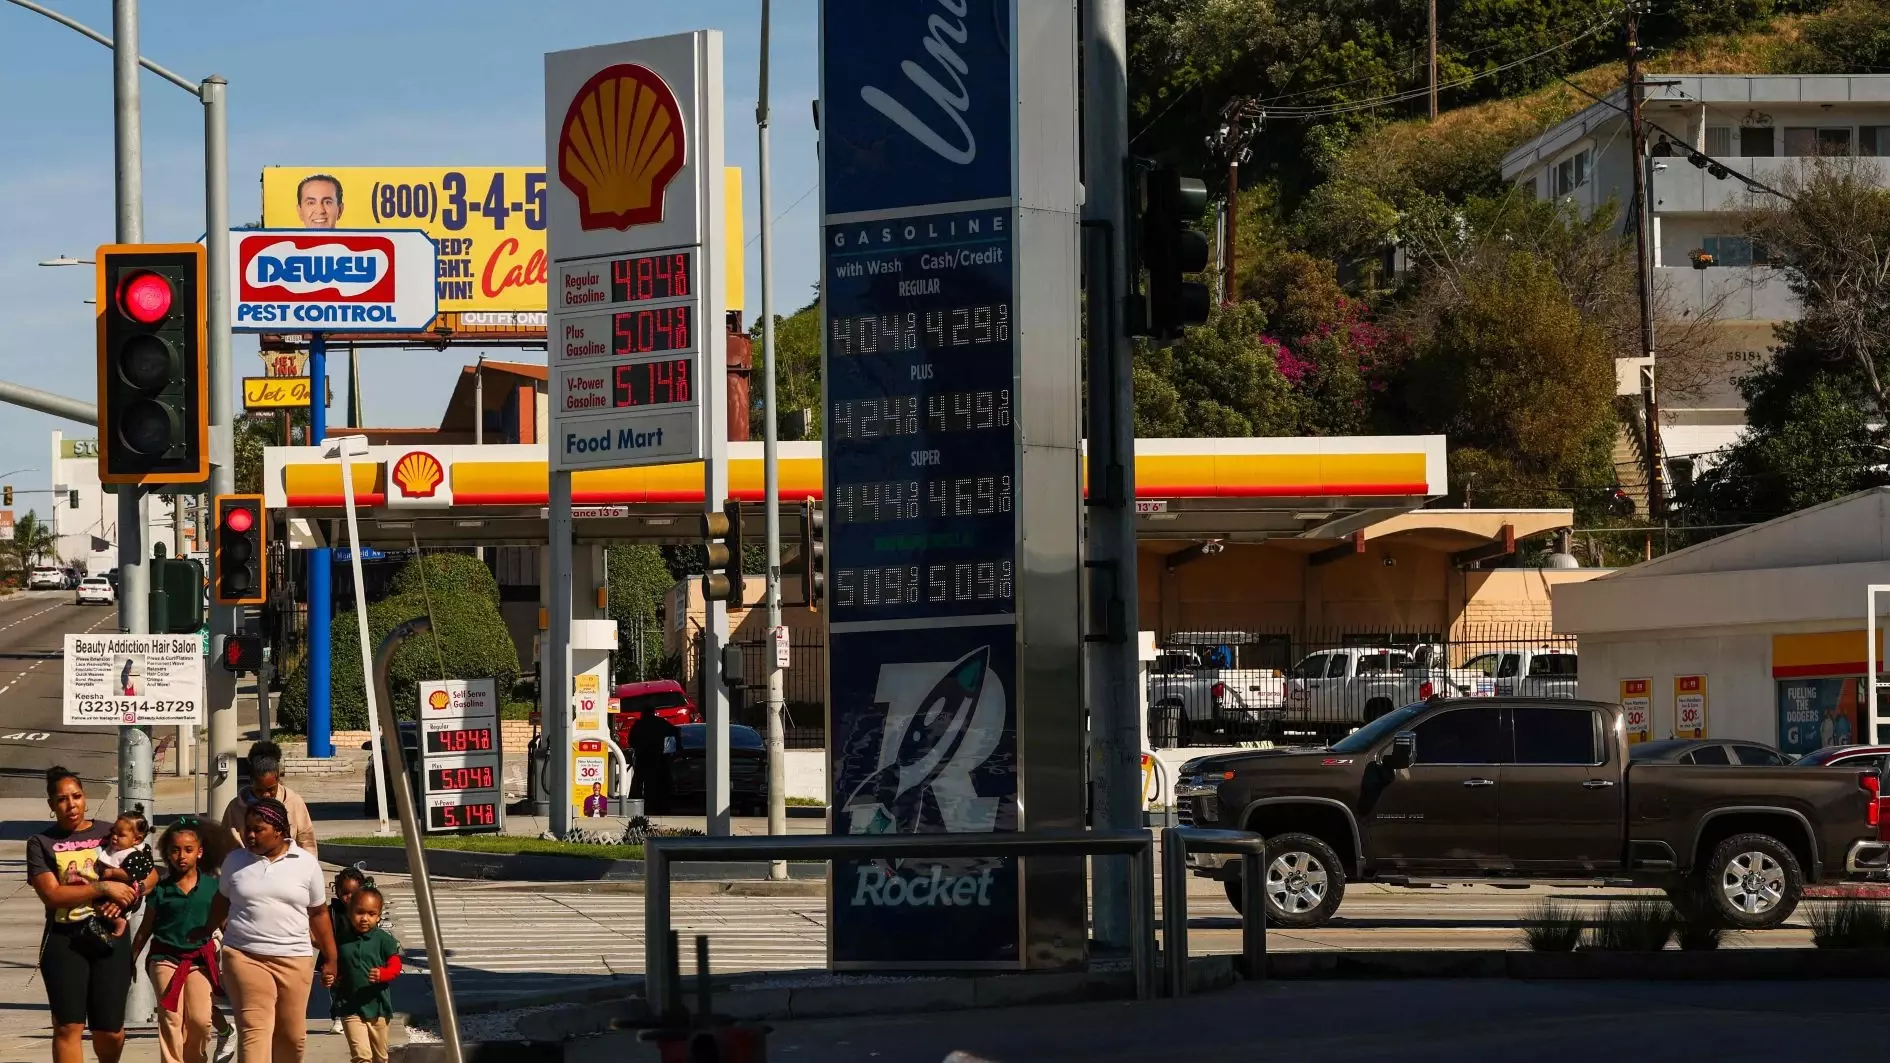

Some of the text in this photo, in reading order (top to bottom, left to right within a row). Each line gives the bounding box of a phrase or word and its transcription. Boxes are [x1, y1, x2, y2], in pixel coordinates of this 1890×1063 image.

[371, 172, 547, 231] (800) 3-4-5
[834, 217, 1003, 247] GASOLINE
[257, 256, 376, 283] DEWEY
[836, 247, 1003, 278] with Wash Cash/Credit
[565, 272, 600, 290] Regular
[899, 278, 940, 297] REGULAR
[565, 288, 605, 305] Gasoline
[237, 304, 397, 322] PEST CONTROL
[566, 325, 584, 340] Plus
[566, 341, 605, 357] Gasoline
[910, 364, 934, 380] PLUS
[248, 383, 286, 402] Jet
[567, 378, 604, 392] V-Power
[567, 393, 606, 409] Gasoline
[566, 427, 663, 454] Food Mart
[911, 450, 940, 467] SUPER
[75, 639, 105, 656] Beauty
[108, 639, 149, 653] Addiction
[152, 639, 170, 653] Hair
[172, 639, 197, 653] Salon
[453, 690, 486, 699] Self Serve
[1787, 687, 1817, 700] FUELING
[79, 700, 195, 715] (323)514-8729
[453, 700, 484, 708] Gasoline
[1796, 699, 1809, 710] THE
[1787, 710, 1819, 722] DODGERS
[851, 863, 995, 907] Rocket
